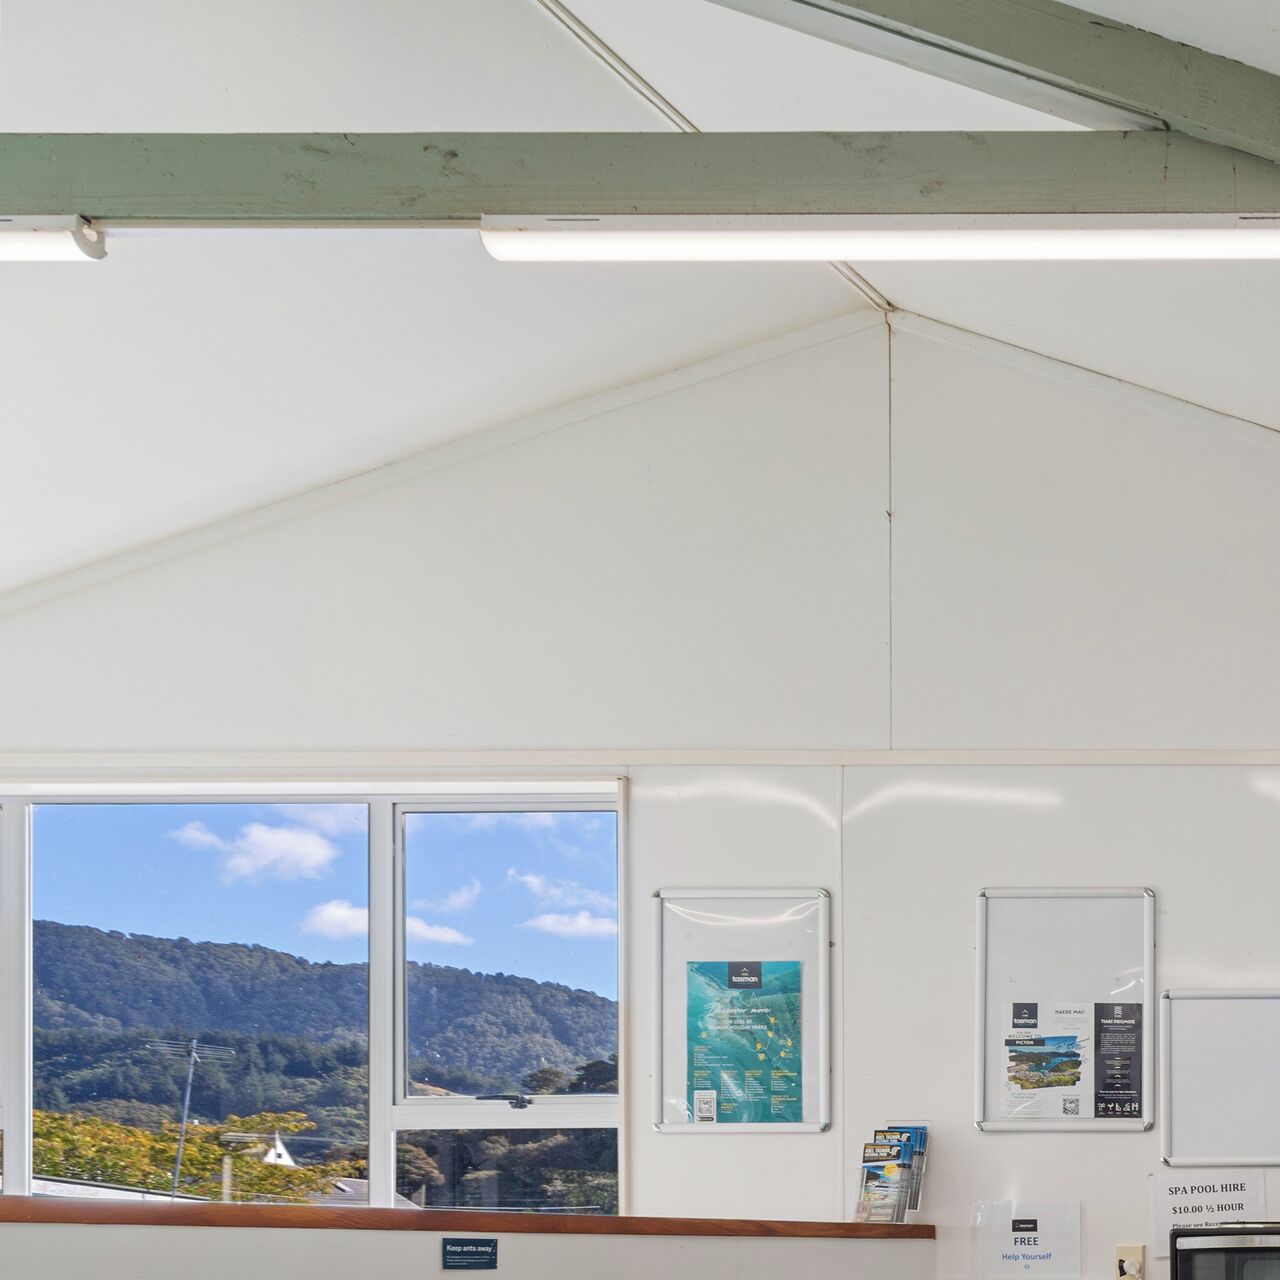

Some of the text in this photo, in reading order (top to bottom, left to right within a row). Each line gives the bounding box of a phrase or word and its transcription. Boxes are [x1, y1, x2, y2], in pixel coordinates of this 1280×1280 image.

[1168, 1183, 1246, 1195] SPA POOL HIRE
[1172, 1205, 1203, 1215] $10.00
[1217, 1203, 1244, 1212] HOUR
[1014, 1237, 1039, 1246] FREE
[446, 1245, 462, 1253] Keep
[1002, 1252, 1052, 1261] Help Yourself
